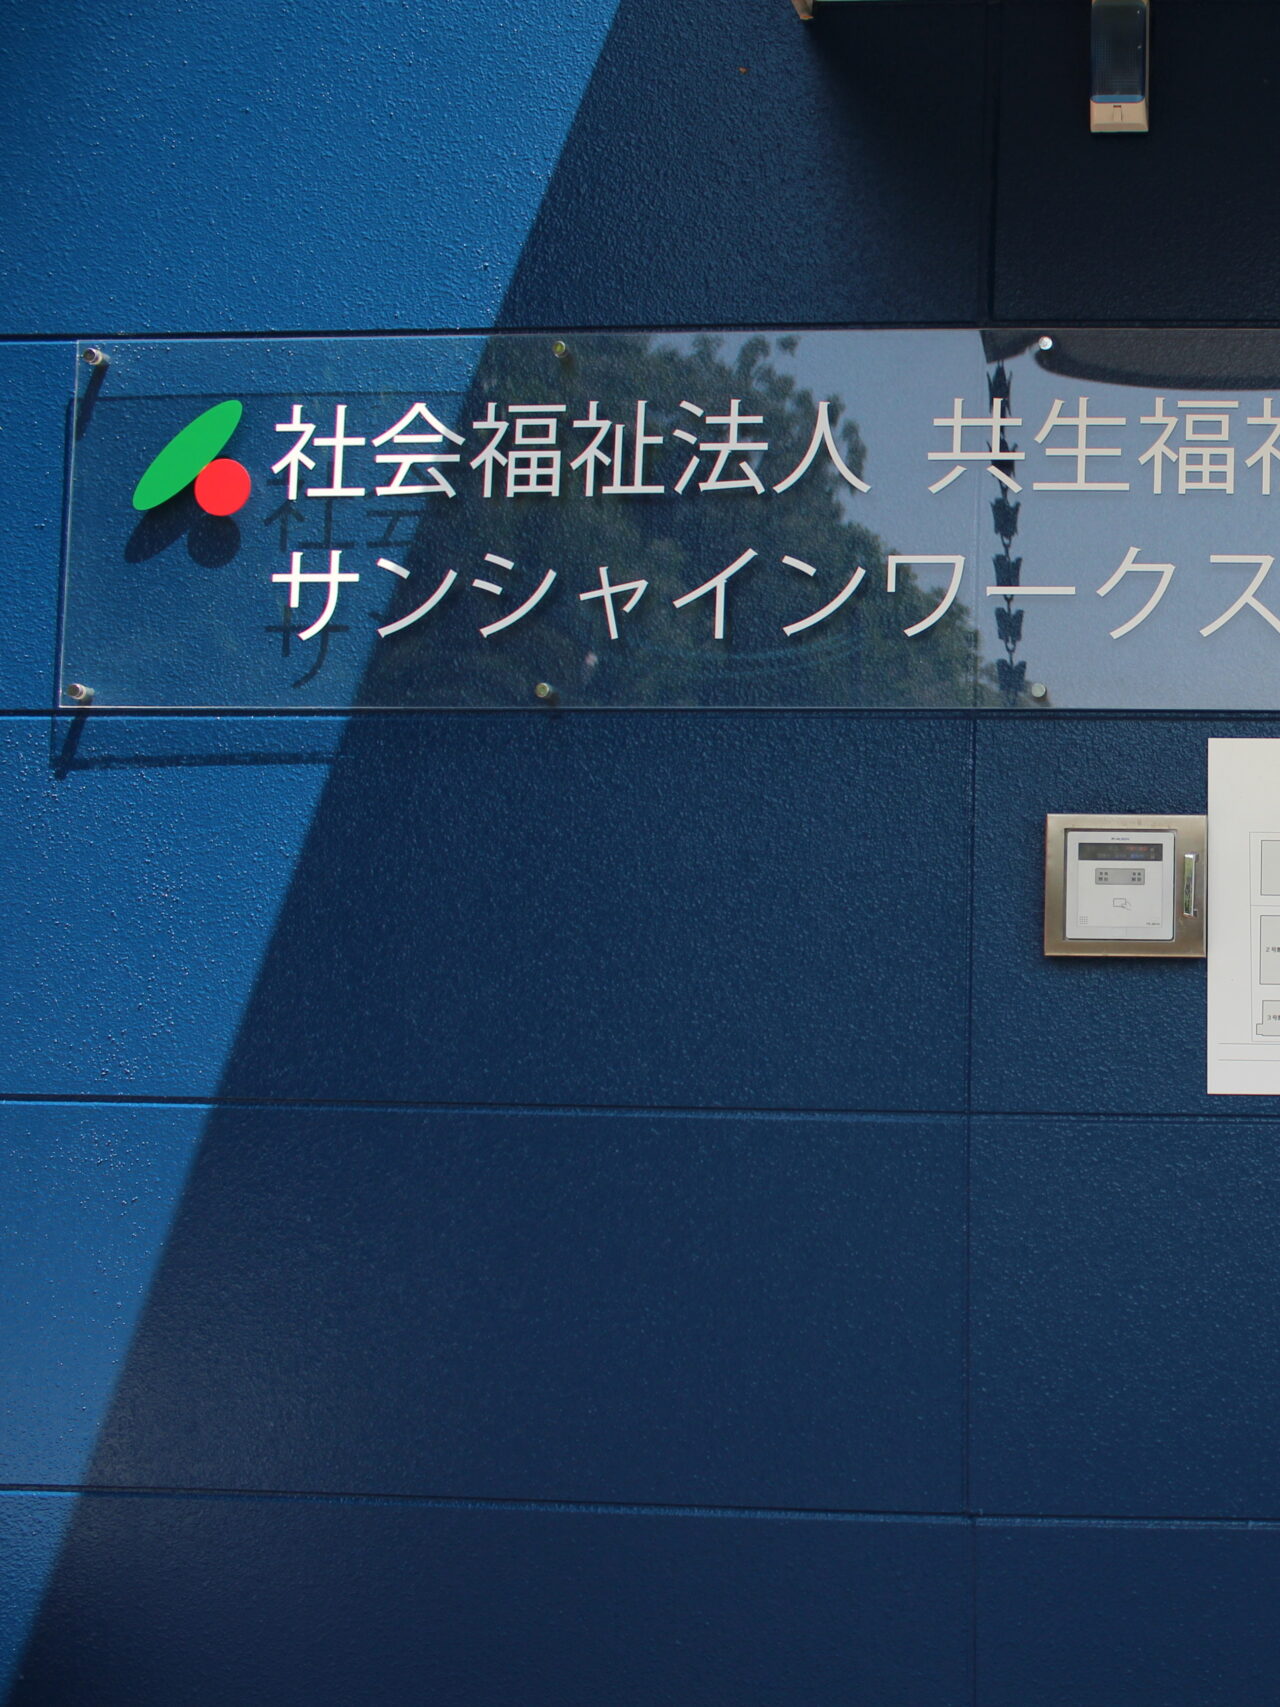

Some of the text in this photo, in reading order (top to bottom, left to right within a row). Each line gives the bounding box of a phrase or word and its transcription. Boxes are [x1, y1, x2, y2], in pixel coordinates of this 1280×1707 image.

[271, 399, 872, 500] 社会福祉法人
